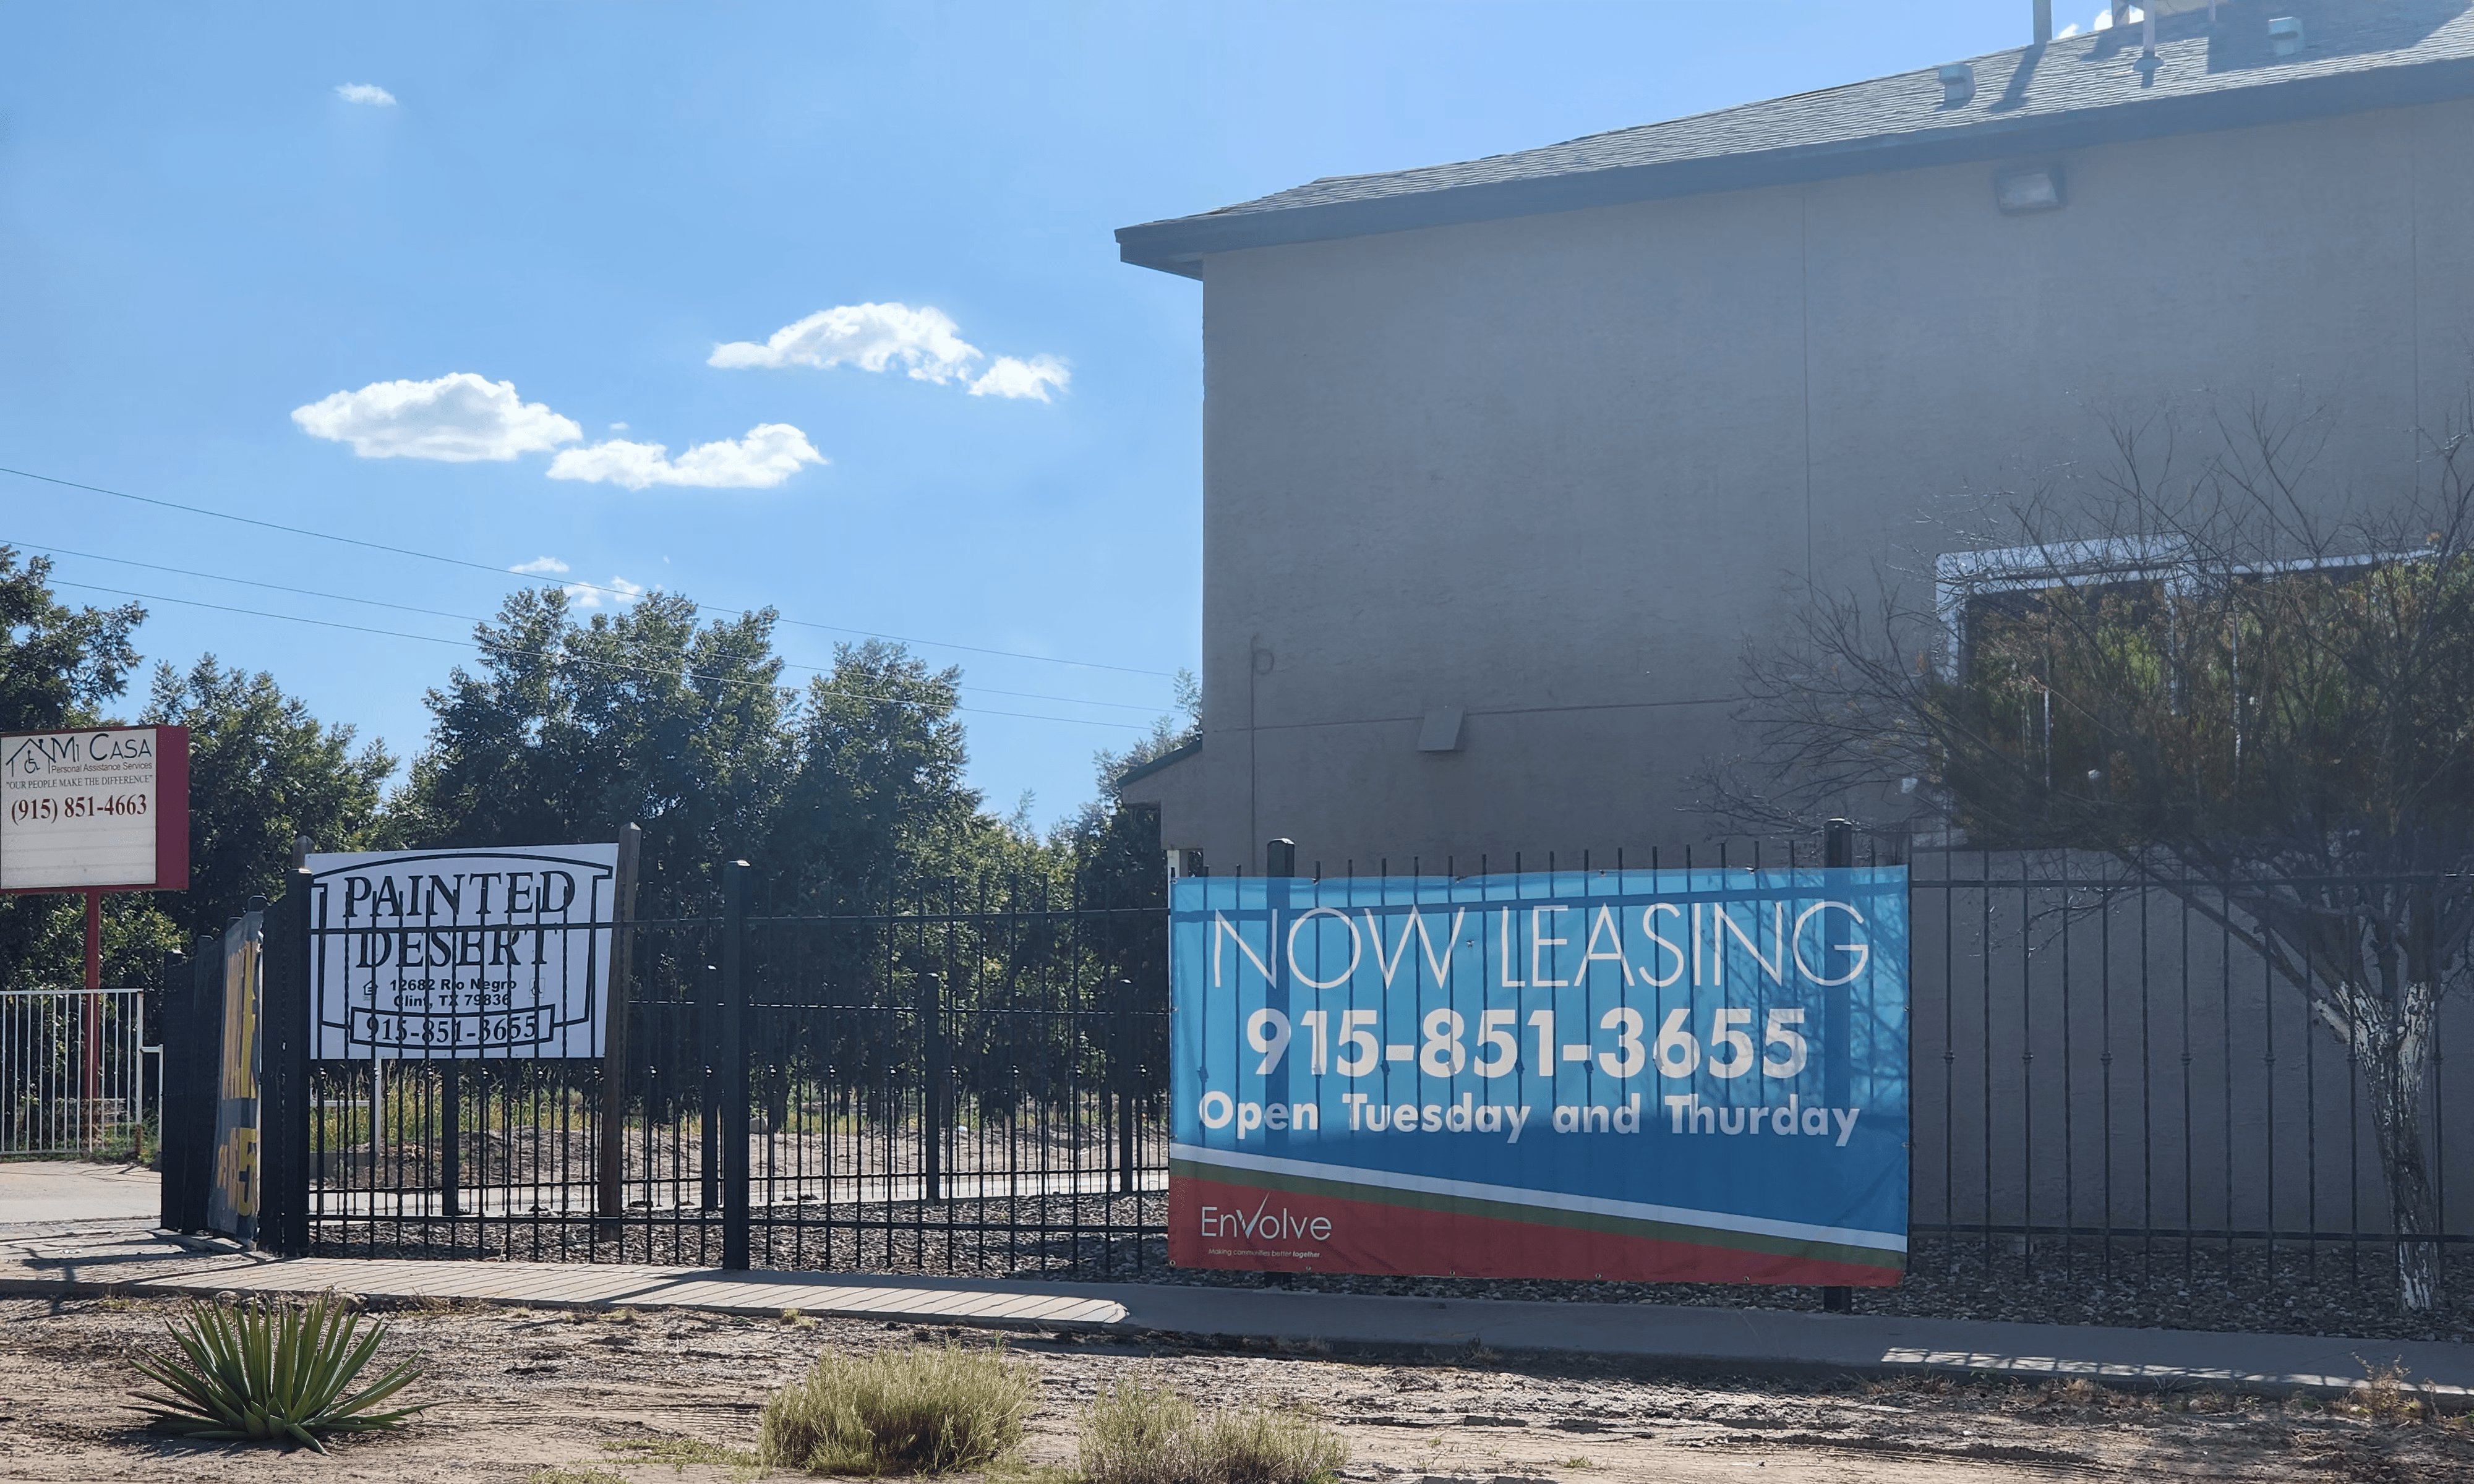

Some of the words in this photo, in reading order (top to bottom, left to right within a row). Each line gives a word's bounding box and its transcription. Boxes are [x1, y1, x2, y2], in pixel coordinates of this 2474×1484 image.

[28, 779, 58, 788] PEOPLE
[59, 778, 82, 787] MAKE
[85, 777, 100, 786] THE
[51, 764, 82, 773] Personal
[83, 763, 121, 772] Assistance
[123, 762, 152, 770] Services
[11, 798, 58, 825] (915)
[64, 794, 147, 817] 851-4663
[343, 871, 576, 918] PAINTED
[356, 926, 558, 968] DESERT
[1215, 905, 1466, 989] NOW
[1501, 900, 1869, 988] LEASING
[390, 979, 435, 991] 12682
[439, 995, 458, 1007] TX
[464, 994, 511, 1006] 79836
[1246, 1008, 1807, 1078] 915-851-3655
[1198, 1091, 1319, 1139] Open
[1341, 1092, 1530, 1144] Tuesday
[1553, 1093, 1640, 1134] and
[1664, 1094, 1860, 1147] Thurday
